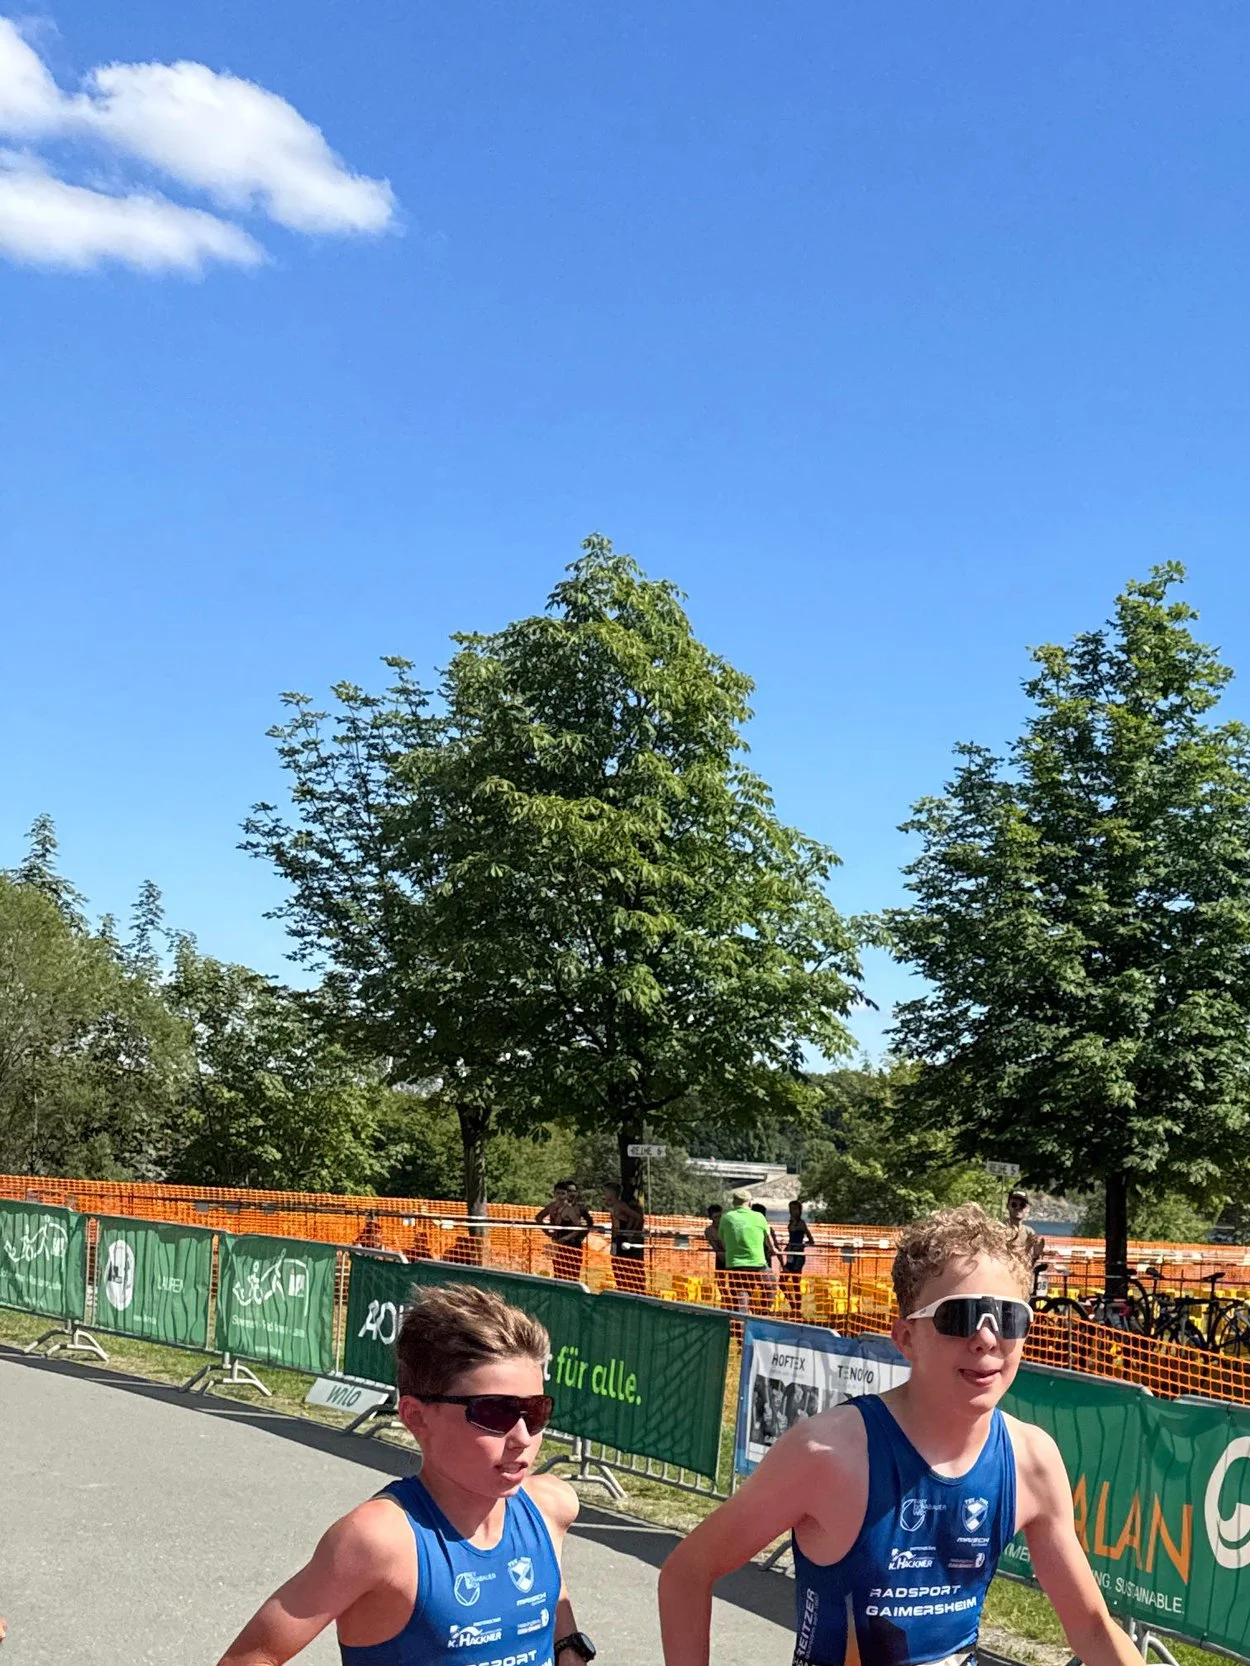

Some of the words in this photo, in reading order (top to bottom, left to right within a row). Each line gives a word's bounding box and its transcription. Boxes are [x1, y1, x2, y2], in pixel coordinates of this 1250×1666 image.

[357, 1299, 405, 1345] AO
[556, 1345, 589, 1390] für
[591, 1358, 642, 1405] alle.
[772, 1353, 806, 1372] HOFTEX
[325, 1385, 362, 1408] wilo
[1072, 1473, 1193, 1586] ALAN
[865, 1596, 977, 1617] GAIMERSHEIM
[869, 1584, 961, 1598] RADSPORT
[1115, 1576, 1186, 1615] SUSTAINABLE.
